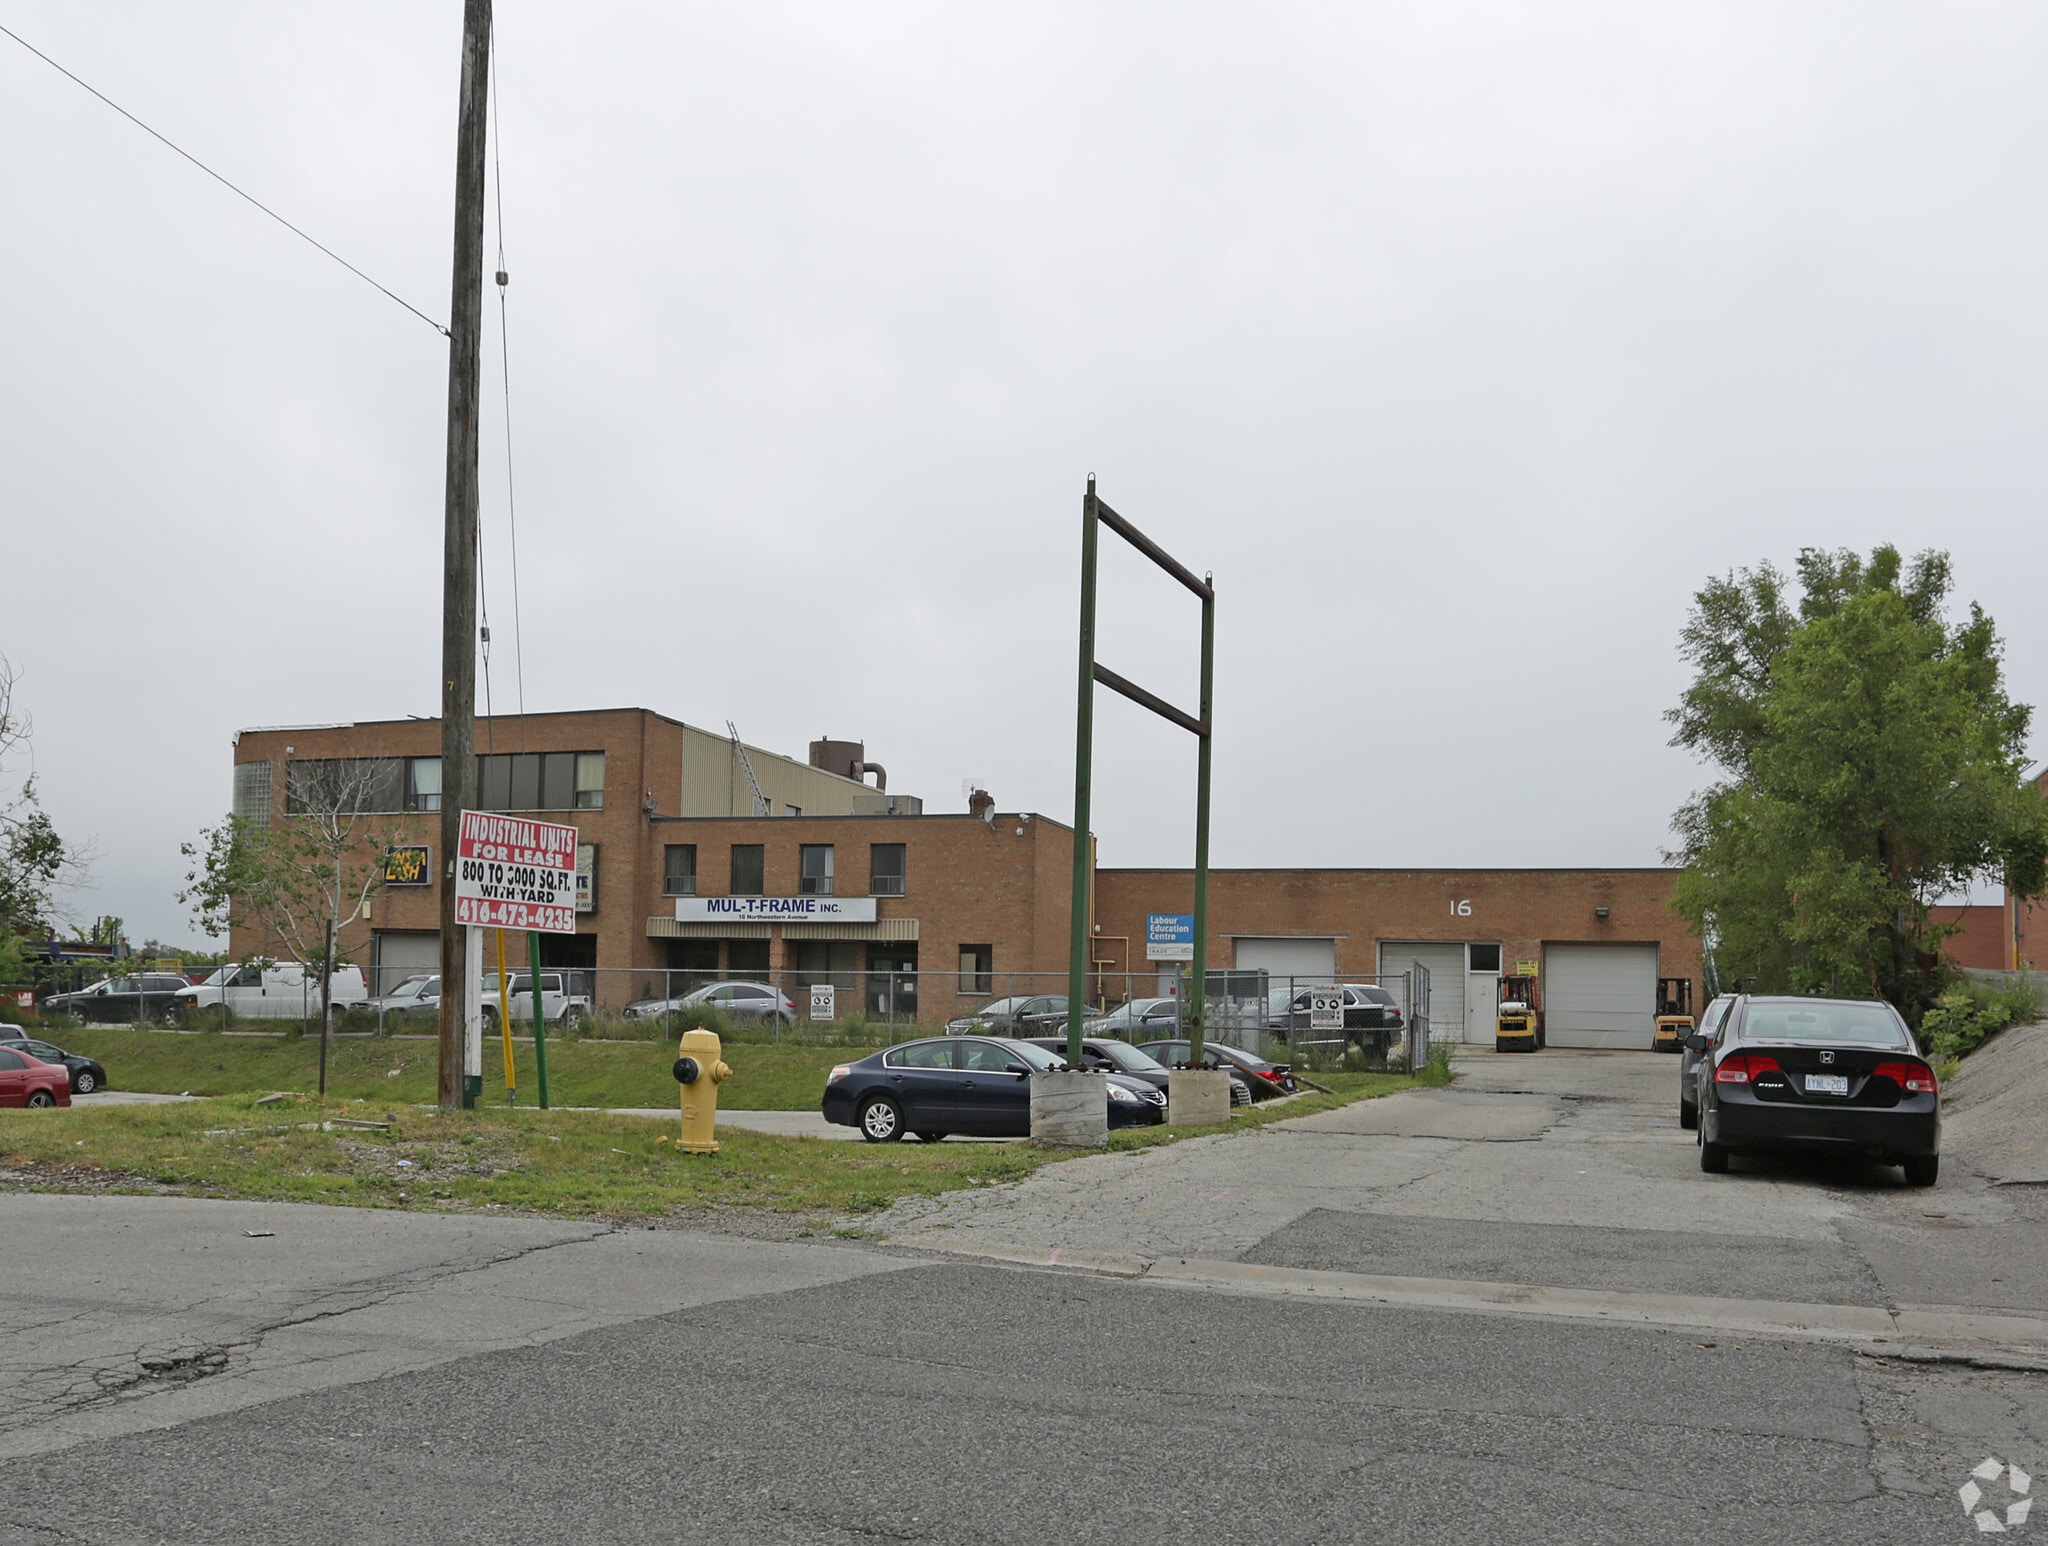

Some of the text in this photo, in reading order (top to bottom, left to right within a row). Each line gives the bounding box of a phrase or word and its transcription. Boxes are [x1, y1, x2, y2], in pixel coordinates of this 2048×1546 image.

[465, 814, 573, 854] INDUSTRIAL UNITS
[472, 843, 563, 868] FOR LEASE
[462, 861, 484, 882] 800
[489, 863, 503, 884] TO
[480, 884, 555, 904] WITH YARD
[459, 899, 573, 931] 416-473-4235
[707, 899, 842, 914] MUL-T-FRAME INC.
[1450, 900, 1472, 916] 16
[1150, 915, 1178, 925] Labour
[1150, 924, 1189, 933] Education
[1150, 932, 1177, 941] Centre
